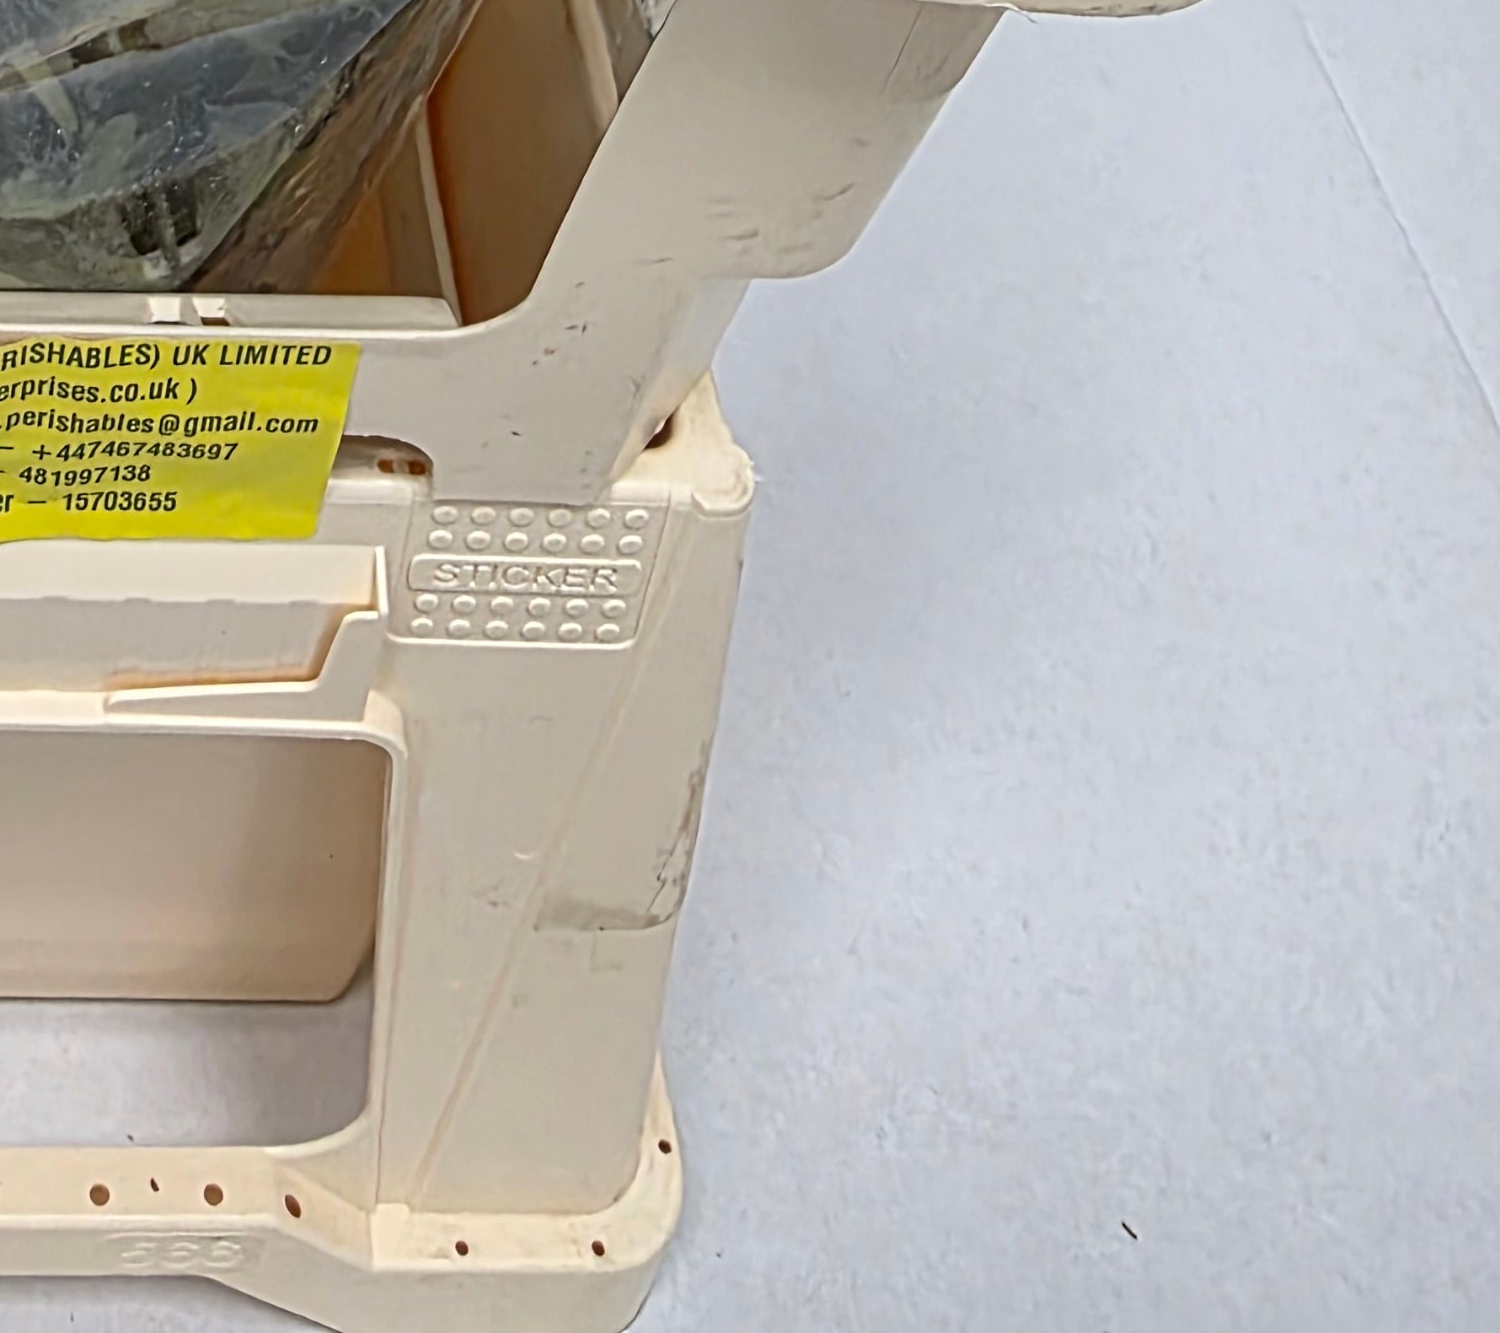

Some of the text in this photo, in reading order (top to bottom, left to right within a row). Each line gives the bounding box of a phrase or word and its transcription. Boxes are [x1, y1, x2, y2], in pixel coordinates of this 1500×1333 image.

[172, 342, 211, 367] UK
[218, 342, 333, 366] LIMITED
[31, 440, 240, 463] +447467483697
[18, 462, 153, 488] 481997138
[61, 490, 178, 512] 15703655
[433, 564, 618, 590] STICKER
